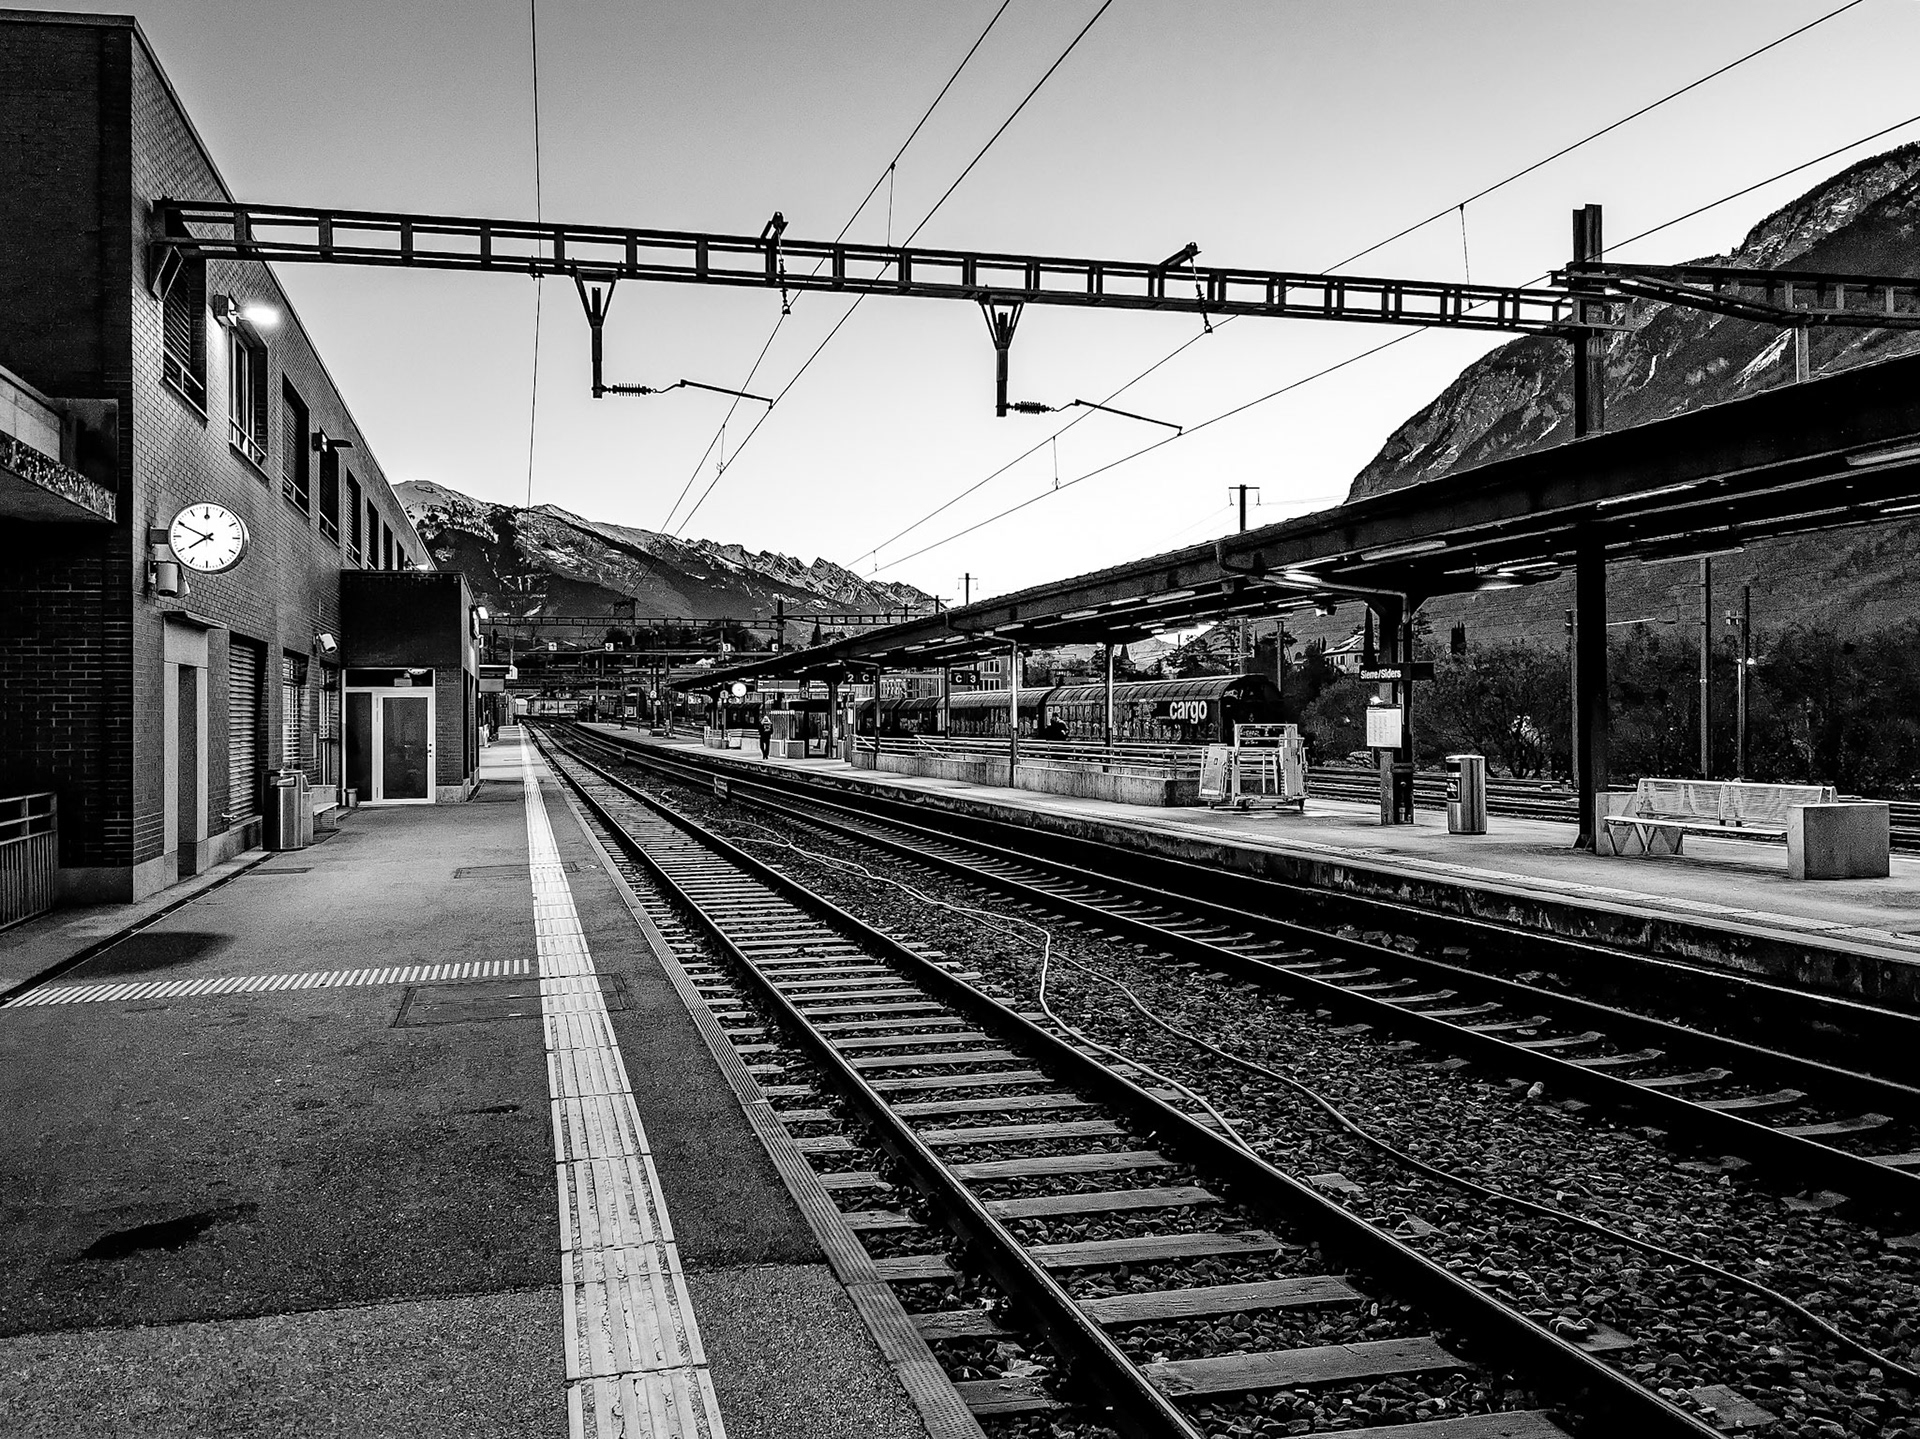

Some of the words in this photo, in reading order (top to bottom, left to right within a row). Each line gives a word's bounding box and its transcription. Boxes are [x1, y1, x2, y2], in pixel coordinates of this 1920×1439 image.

[847, 673, 854, 682] 2
[862, 673, 870, 682] C
[955, 674, 962, 683] C
[970, 674, 977, 683] 3
[1169, 700, 1208, 725] cargo
